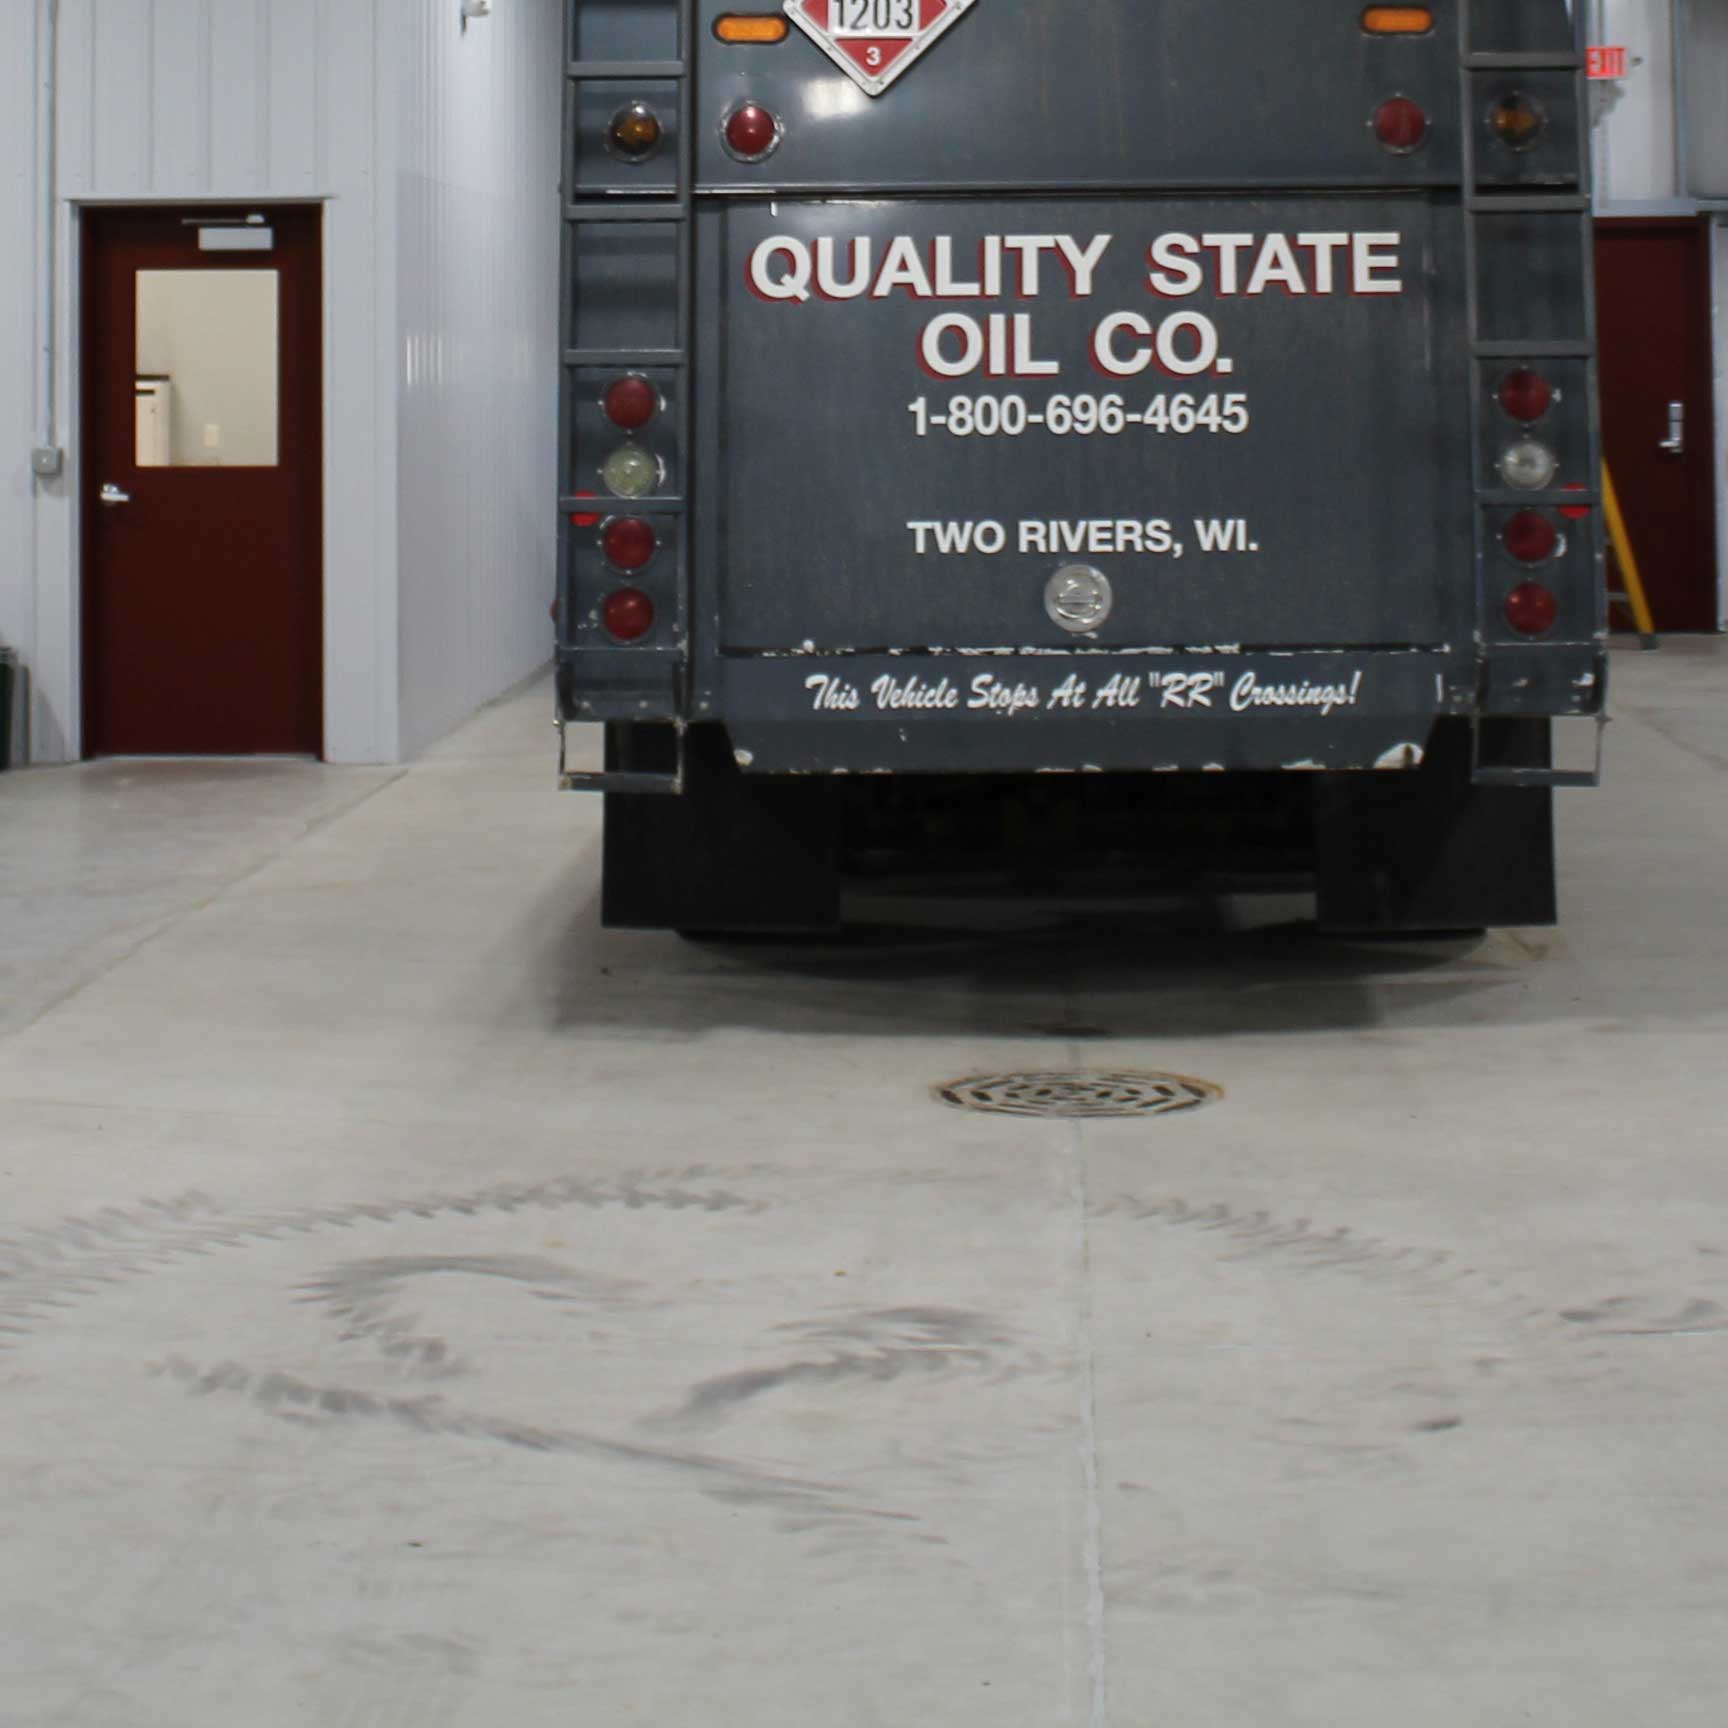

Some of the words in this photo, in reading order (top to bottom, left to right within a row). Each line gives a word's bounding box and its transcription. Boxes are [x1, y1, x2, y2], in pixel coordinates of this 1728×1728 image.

[865, 46, 882, 67] 3
[748, 234, 1112, 303] QUALITY
[1147, 232, 1402, 297] STATE
[919, 312, 1060, 378] OIL
[1092, 311, 1233, 377] CO.
[907, 392, 1249, 436] 1-800-696-4645
[906, 520, 1006, 554] TWO
[1018, 519, 1183, 558] RIVERS,
[1193, 518, 1260, 552] WI.
[805, 674, 860, 710] This
[870, 674, 959, 710] Vehicle
[966, 673, 1039, 711] Stops
[1046, 674, 1087, 710] At
[1091, 673, 1141, 709] All
[1148, 671, 1226, 709] "RR"
[1229, 670, 1363, 716] Crossings!
